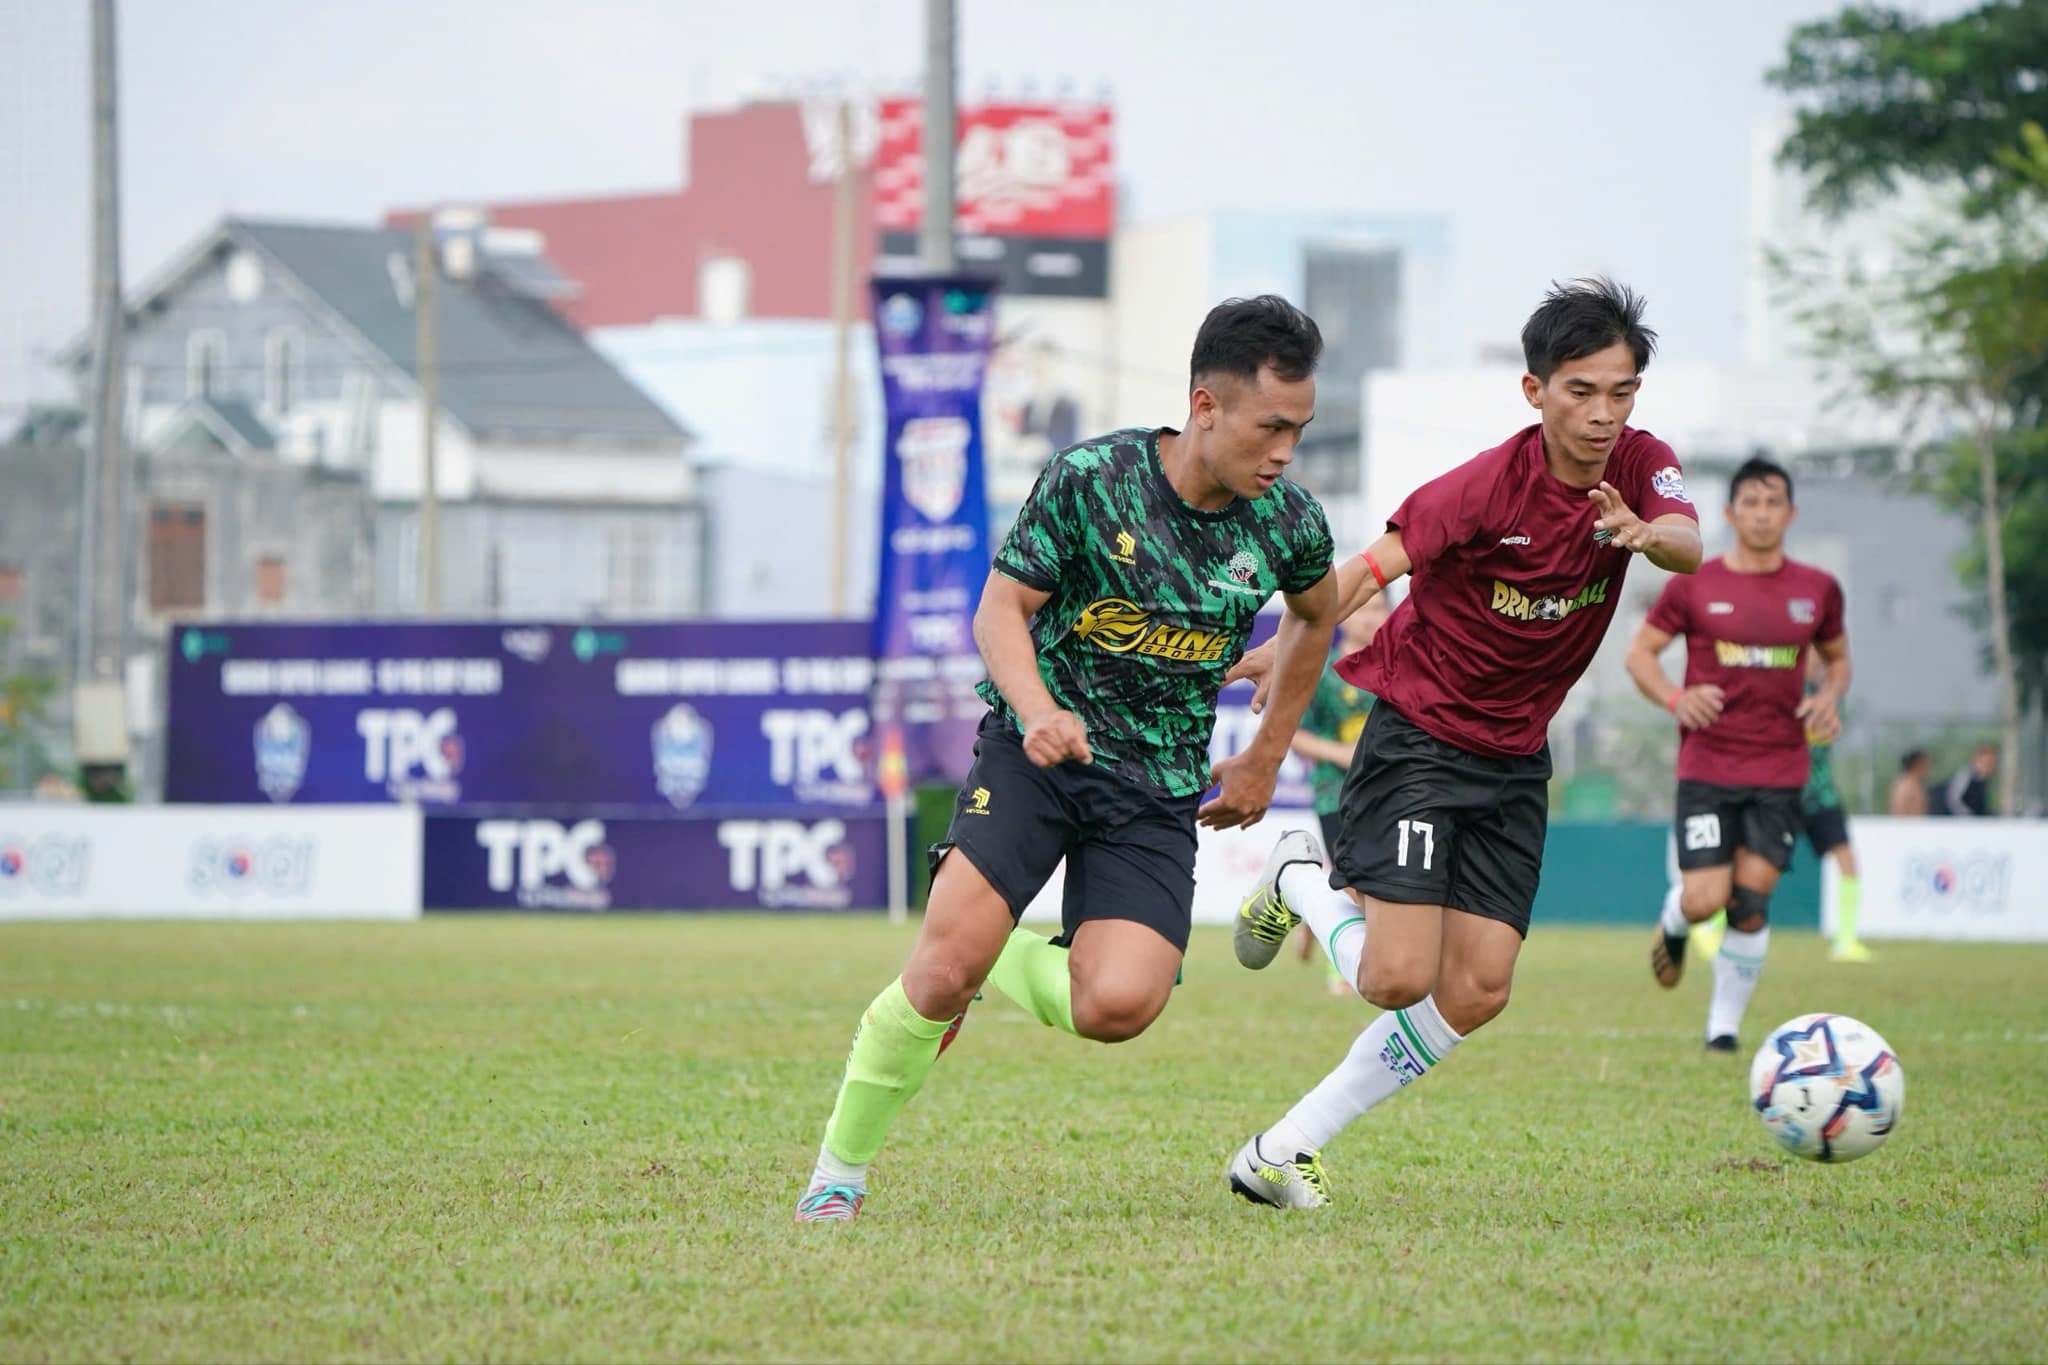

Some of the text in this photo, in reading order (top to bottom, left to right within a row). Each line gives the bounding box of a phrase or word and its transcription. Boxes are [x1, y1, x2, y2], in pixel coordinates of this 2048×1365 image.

[1142, 643, 1218, 661] SPORTS
[1145, 624, 1230, 651] KING
[357, 706, 459, 783] TPC
[760, 707, 870, 786] TPC
[476, 818, 606, 892] TPC
[717, 818, 846, 892] TPC
[1398, 820, 1434, 870] 17
[1685, 813, 1721, 850] 20
